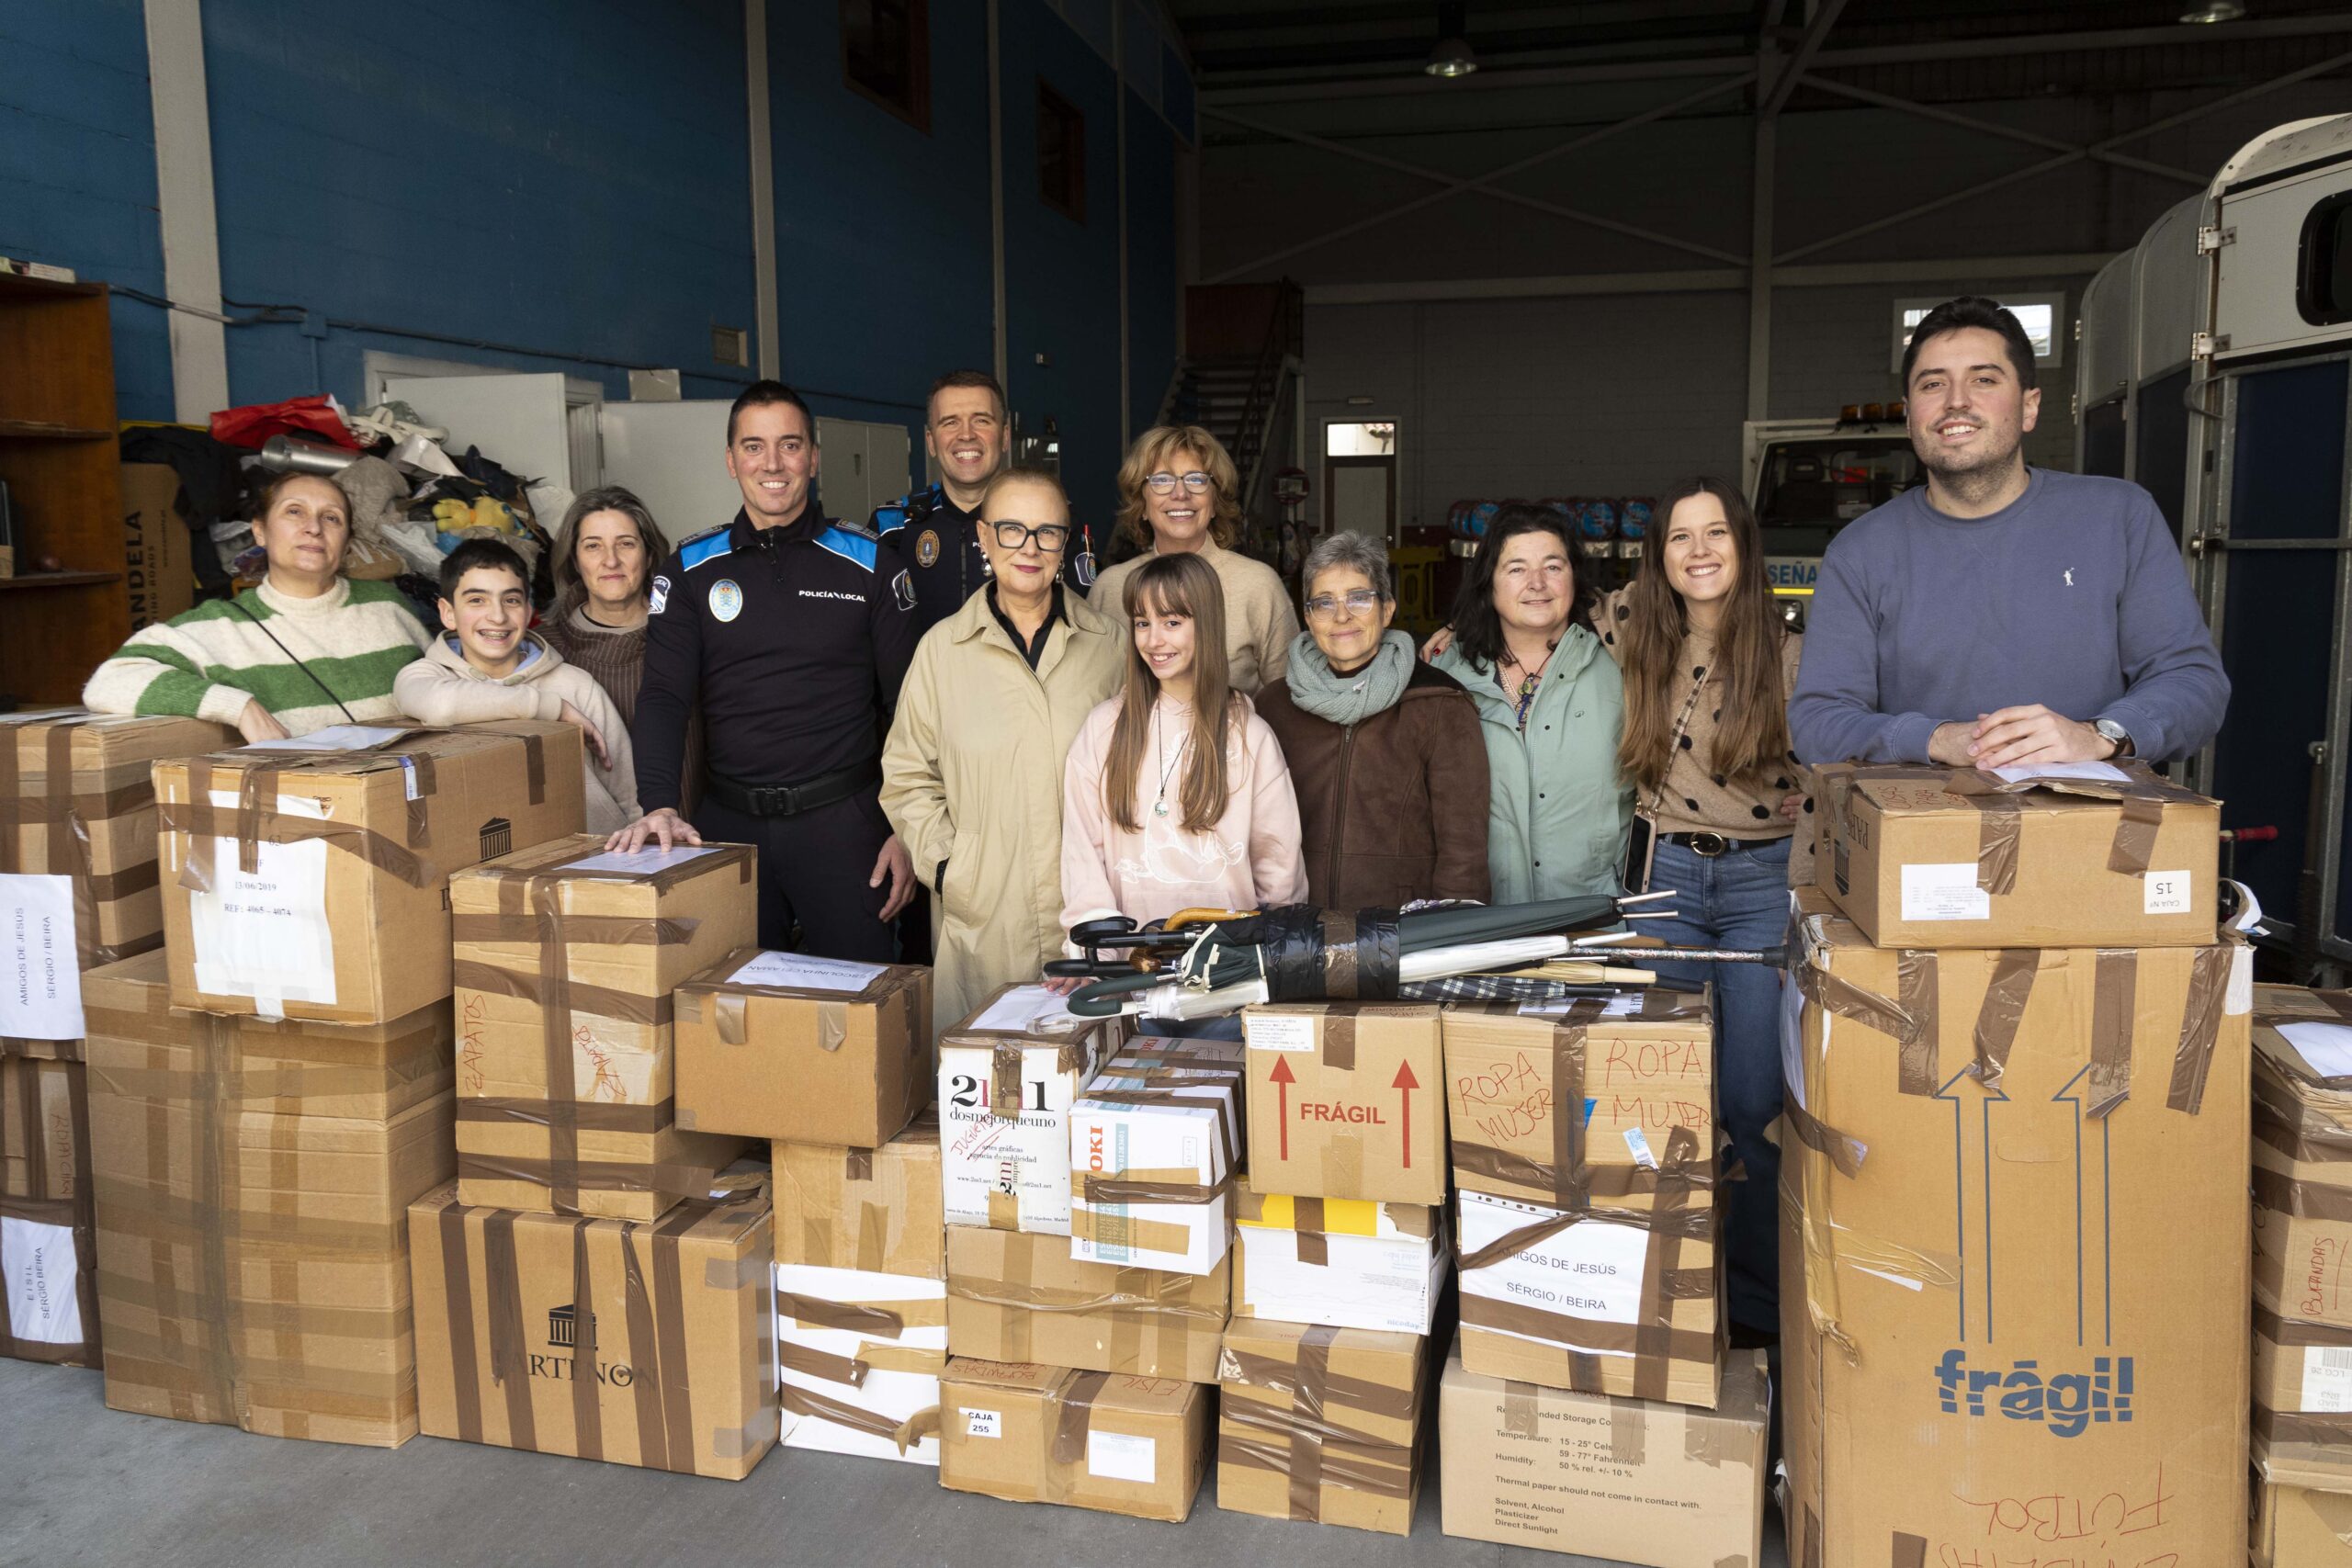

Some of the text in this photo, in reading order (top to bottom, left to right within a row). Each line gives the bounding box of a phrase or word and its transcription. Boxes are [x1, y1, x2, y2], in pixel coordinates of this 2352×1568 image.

[798, 590, 866, 603] POLICÍA LOCAL
[2155, 882, 2173, 895] 15
[2161, 899, 2180, 908] CAJA
[42, 916, 52, 949] BEIRA
[17, 945, 26, 960] DE
[18, 963, 29, 1006] AMIGOS
[45, 957, 56, 999] SÉRGIO
[463, 993, 487, 1091] ZAPATOS
[1606, 1037, 1703, 1088] ROPA
[1458, 1052, 1541, 1116] ROPA
[949, 1106, 1057, 1130] dosmejorqueuno
[1300, 1101, 1386, 1124] FRÁGIL
[1476, 1089, 1555, 1147] MUJER
[1613, 1094, 1712, 1131] MUJER
[998, 1145, 1023, 1154] gráficas
[1090, 1125, 1103, 1172] OKI
[1498, 1249, 1617, 1275] AMIGOS DE JESÚS
[35, 1247, 51, 1319] SÉRGIO BEIRA
[2301, 1236, 2335, 1316] BUFANDAS
[1506, 1281, 1556, 1302] SÉRGIO
[1566, 1296, 1607, 1310] BEIRA
[1934, 1349, 2134, 1438] frágil
[968, 1412, 993, 1421] CAJA
[1496, 1405, 1561, 1420] Rended
[1563, 1414, 1597, 1426] Storage
[972, 1424, 989, 1433] 255
[1496, 1429, 1552, 1443] Temperature:
[1560, 1438, 1570, 1446] 15
[1495, 1453, 1537, 1466] Humidity:
[1571, 1463, 1579, 1472] %
[1582, 1465, 1595, 1473] rel.
[1612, 1469, 1623, 1477] 10
[1624, 1470, 1634, 1478] %
[1559, 1450, 1570, 1458] 59
[1495, 1475, 1530, 1487] Thermal
[1532, 1482, 1556, 1492] paper
[1559, 1485, 1589, 1496] should
[1591, 1490, 1606, 1498] not
[1608, 1493, 1632, 1502] come
[1634, 1495, 1643, 1503] in
[1645, 1496, 1679, 1507] contact
[1495, 1497, 1565, 1515] Solvent, Alcohol
[1495, 1508, 1540, 1521] Plasticizer
[1950, 1461, 2176, 1549] FÚTBOL
[1495, 1518, 1558, 1535] Direct Sunlight
